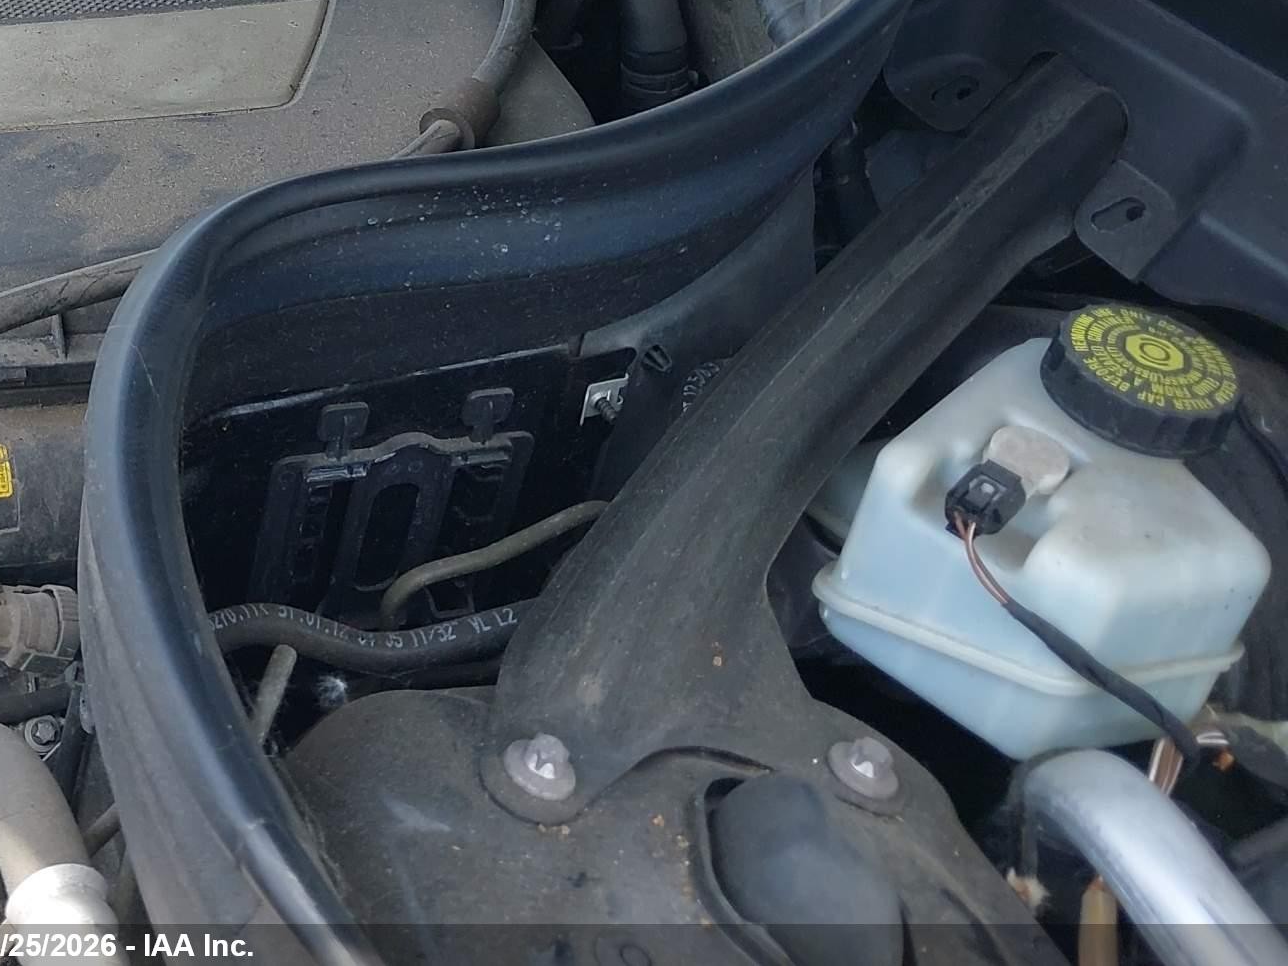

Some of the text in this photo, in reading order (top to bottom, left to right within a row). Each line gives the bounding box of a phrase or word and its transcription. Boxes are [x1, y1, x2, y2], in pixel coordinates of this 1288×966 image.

[1089, 344, 1128, 378] SEALED
[1080, 356, 1131, 393] BEFORE
[1130, 376, 1143, 387] A
[1135, 388, 1165, 407] CAP
